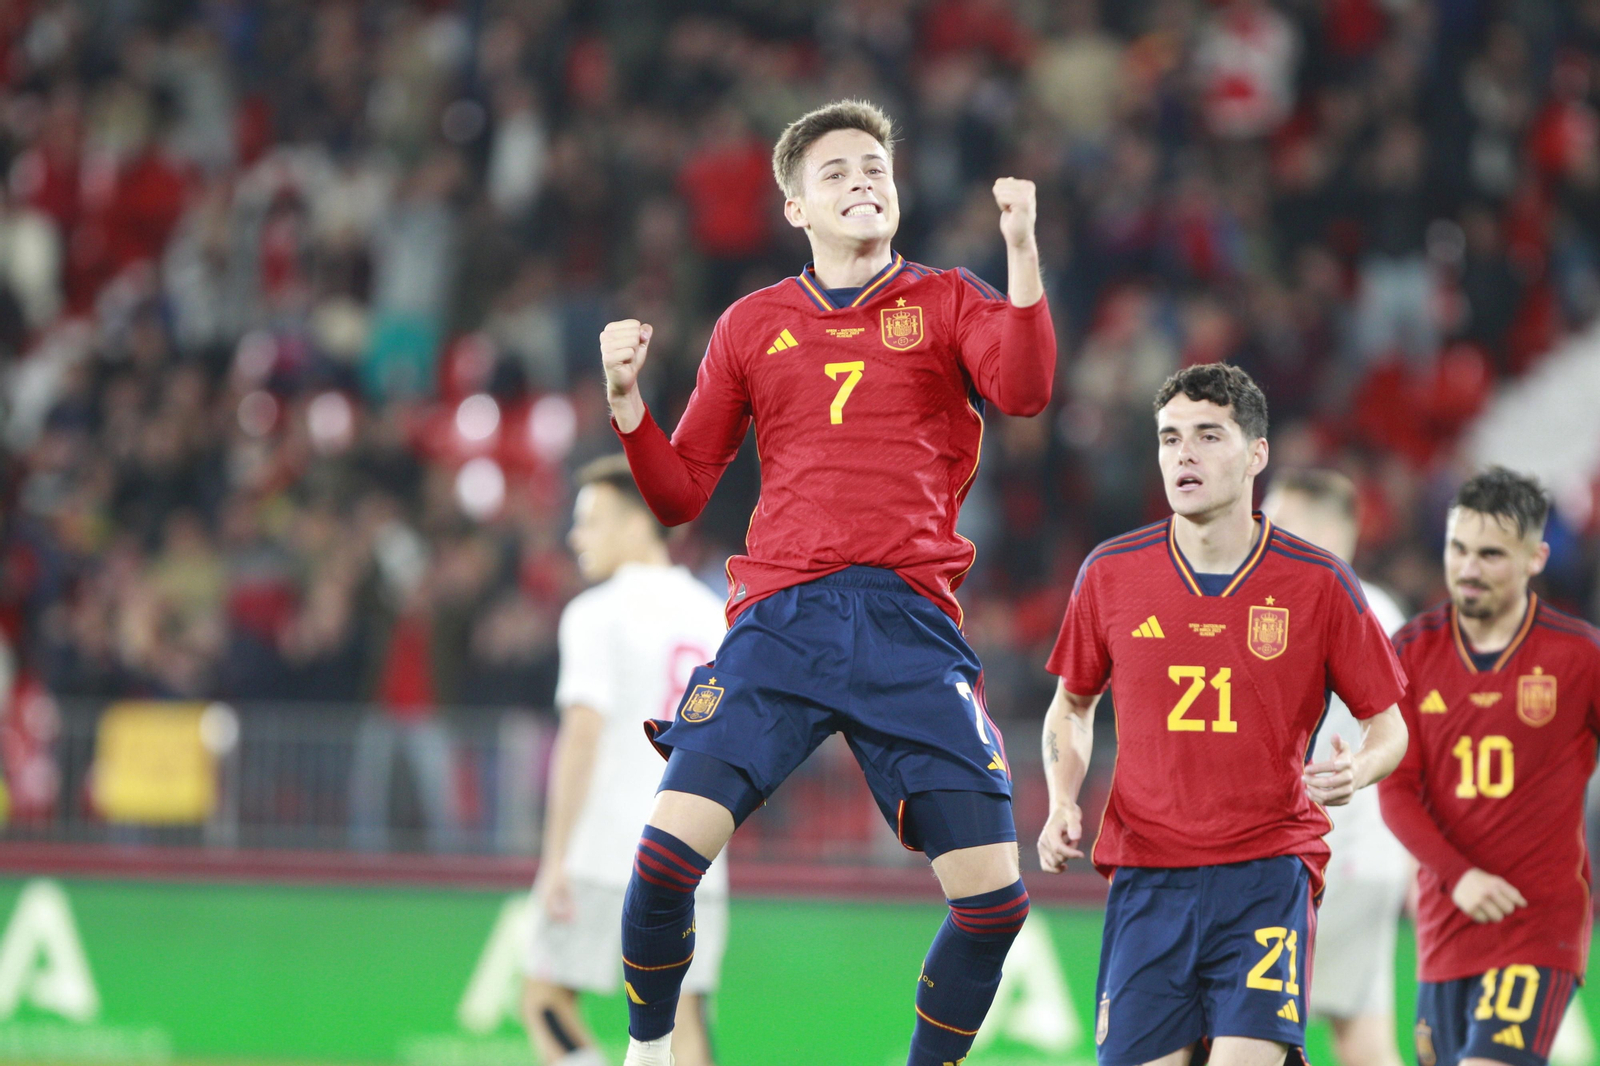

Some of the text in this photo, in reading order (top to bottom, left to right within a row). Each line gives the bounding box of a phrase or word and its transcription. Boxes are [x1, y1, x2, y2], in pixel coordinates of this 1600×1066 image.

[824, 360, 865, 425] 7
[955, 681, 990, 745] 7
[1167, 665, 1238, 733] 21
[1452, 735, 1515, 799] 10
[1246, 926, 1300, 996] 21
[1474, 963, 1541, 1024] 10
